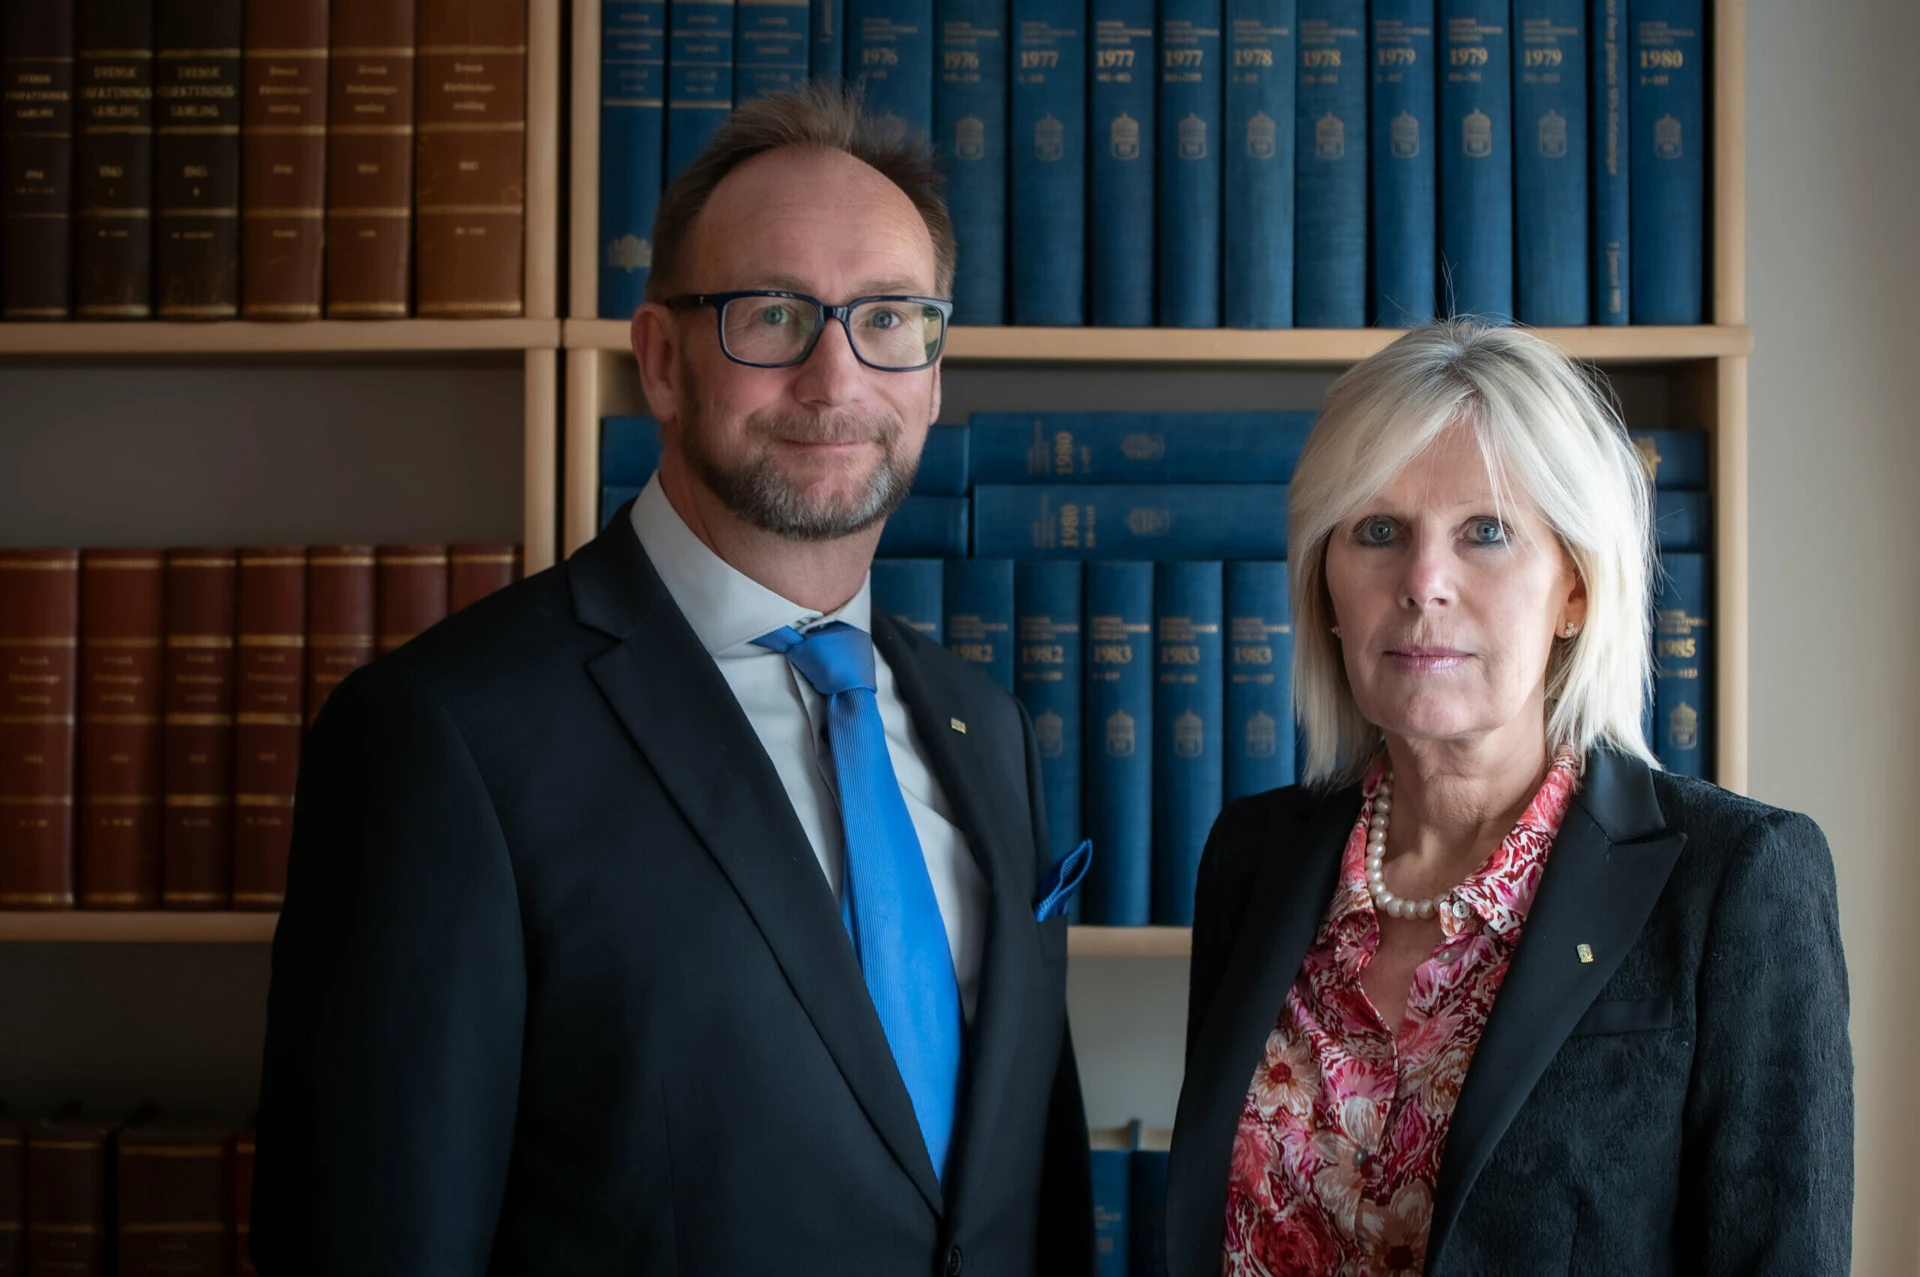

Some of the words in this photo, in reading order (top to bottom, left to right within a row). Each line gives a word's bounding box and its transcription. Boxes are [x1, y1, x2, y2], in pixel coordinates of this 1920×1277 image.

[863, 47, 898, 66] 1976
[944, 51, 979, 69] 1976
[1021, 50, 1059, 68] 1977
[1097, 49, 1135, 67] 1977
[1165, 49, 1203, 67] 1977
[1234, 49, 1272, 67] 1978
[1304, 49, 1341, 67] 1978
[1378, 48, 1416, 66] 1979
[1450, 48, 1488, 66] 1979
[1524, 48, 1562, 66] 1979
[1640, 49, 1683, 68] 1980
[1055, 431, 1074, 475] 1980
[1061, 505, 1079, 547] 1980
[1022, 644, 1064, 664] 1982
[1658, 639, 1696, 658] 1985
